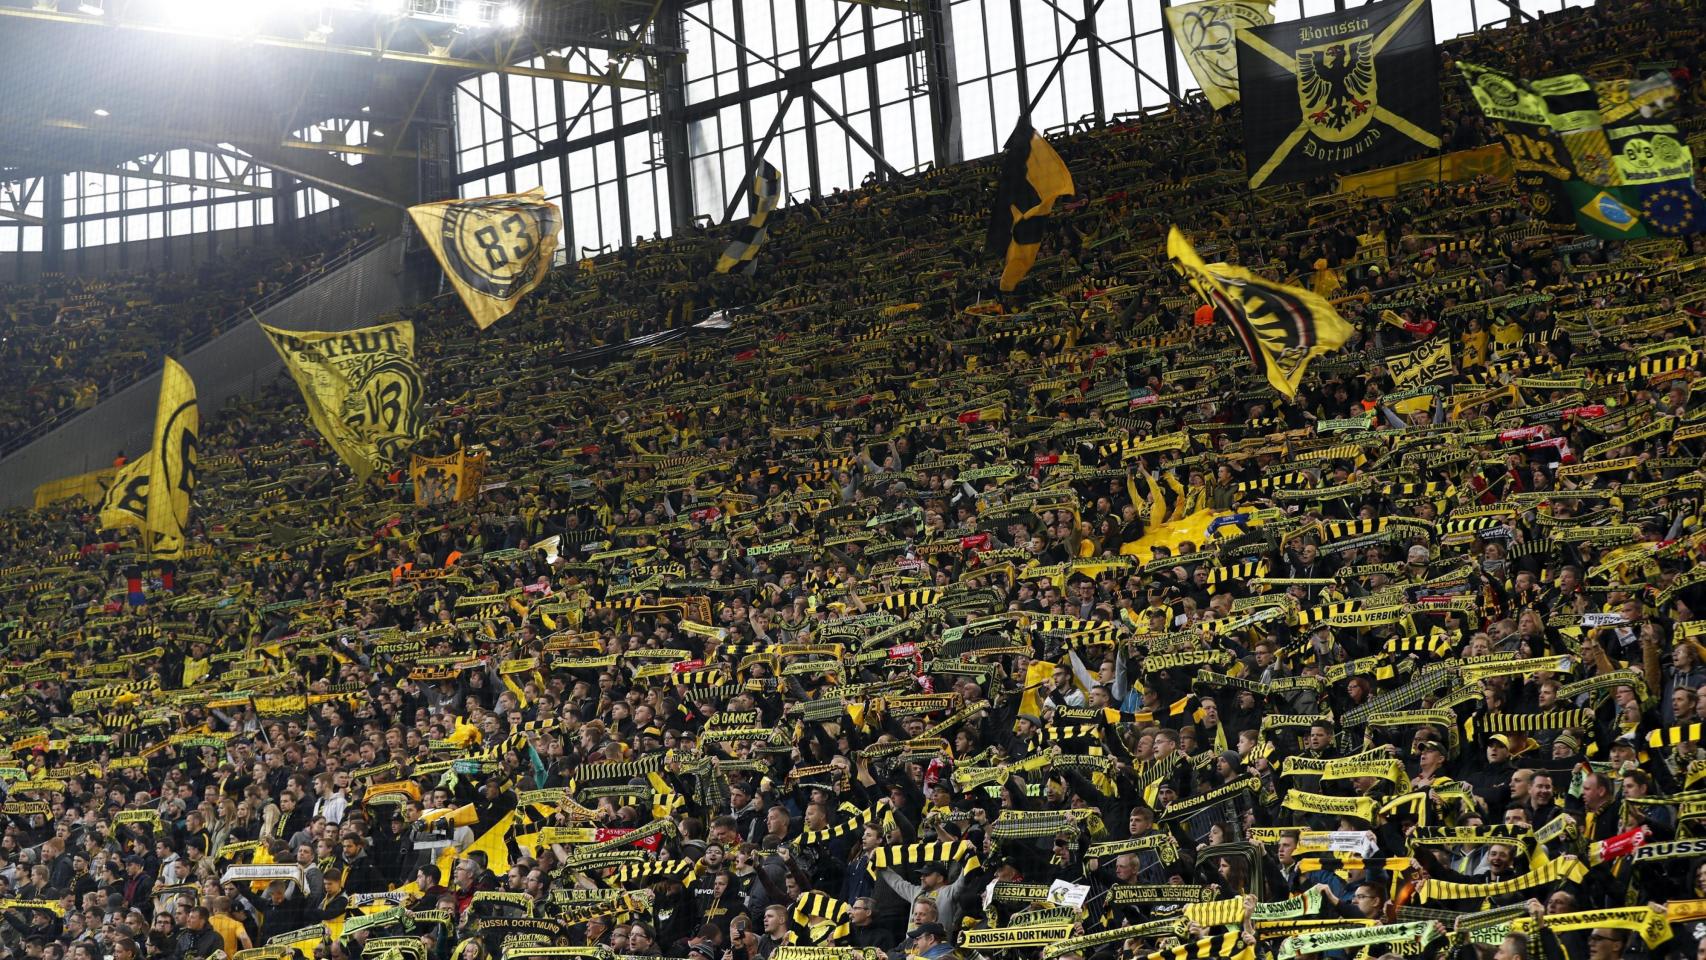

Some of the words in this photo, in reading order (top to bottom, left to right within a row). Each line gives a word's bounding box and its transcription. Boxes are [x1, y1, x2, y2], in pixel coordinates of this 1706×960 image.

[1300, 18, 1369, 41] Borussia
[1304, 128, 1381, 161] Dortmund
[474, 213, 533, 270] 83
[1391, 336, 1441, 377] BLACK
[1401, 355, 1450, 392] STARS
[1453, 505, 1483, 516] RUSSIA
[1484, 502, 1519, 511] DORTMU
[978, 547, 1025, 561] BORUSSIA
[1365, 609, 1402, 622] VERBIN
[722, 712, 756, 725] DANKE
[1271, 714, 1321, 726] BORUSS
[706, 734, 769, 744] DORTMUND
[1292, 758, 1327, 771] BORUSS
[1167, 795, 1206, 813] BORUSSIA
[1206, 779, 1251, 800] DORTMUND
[1640, 841, 1706, 861] RUSS
[1115, 886, 1157, 899] DORTMUND
[1161, 886, 1200, 899] BORUSSIA
[511, 919, 560, 934] DORTMUND
[969, 930, 1015, 944] BORUSSIA
[1016, 928, 1067, 941] DORTMUND
